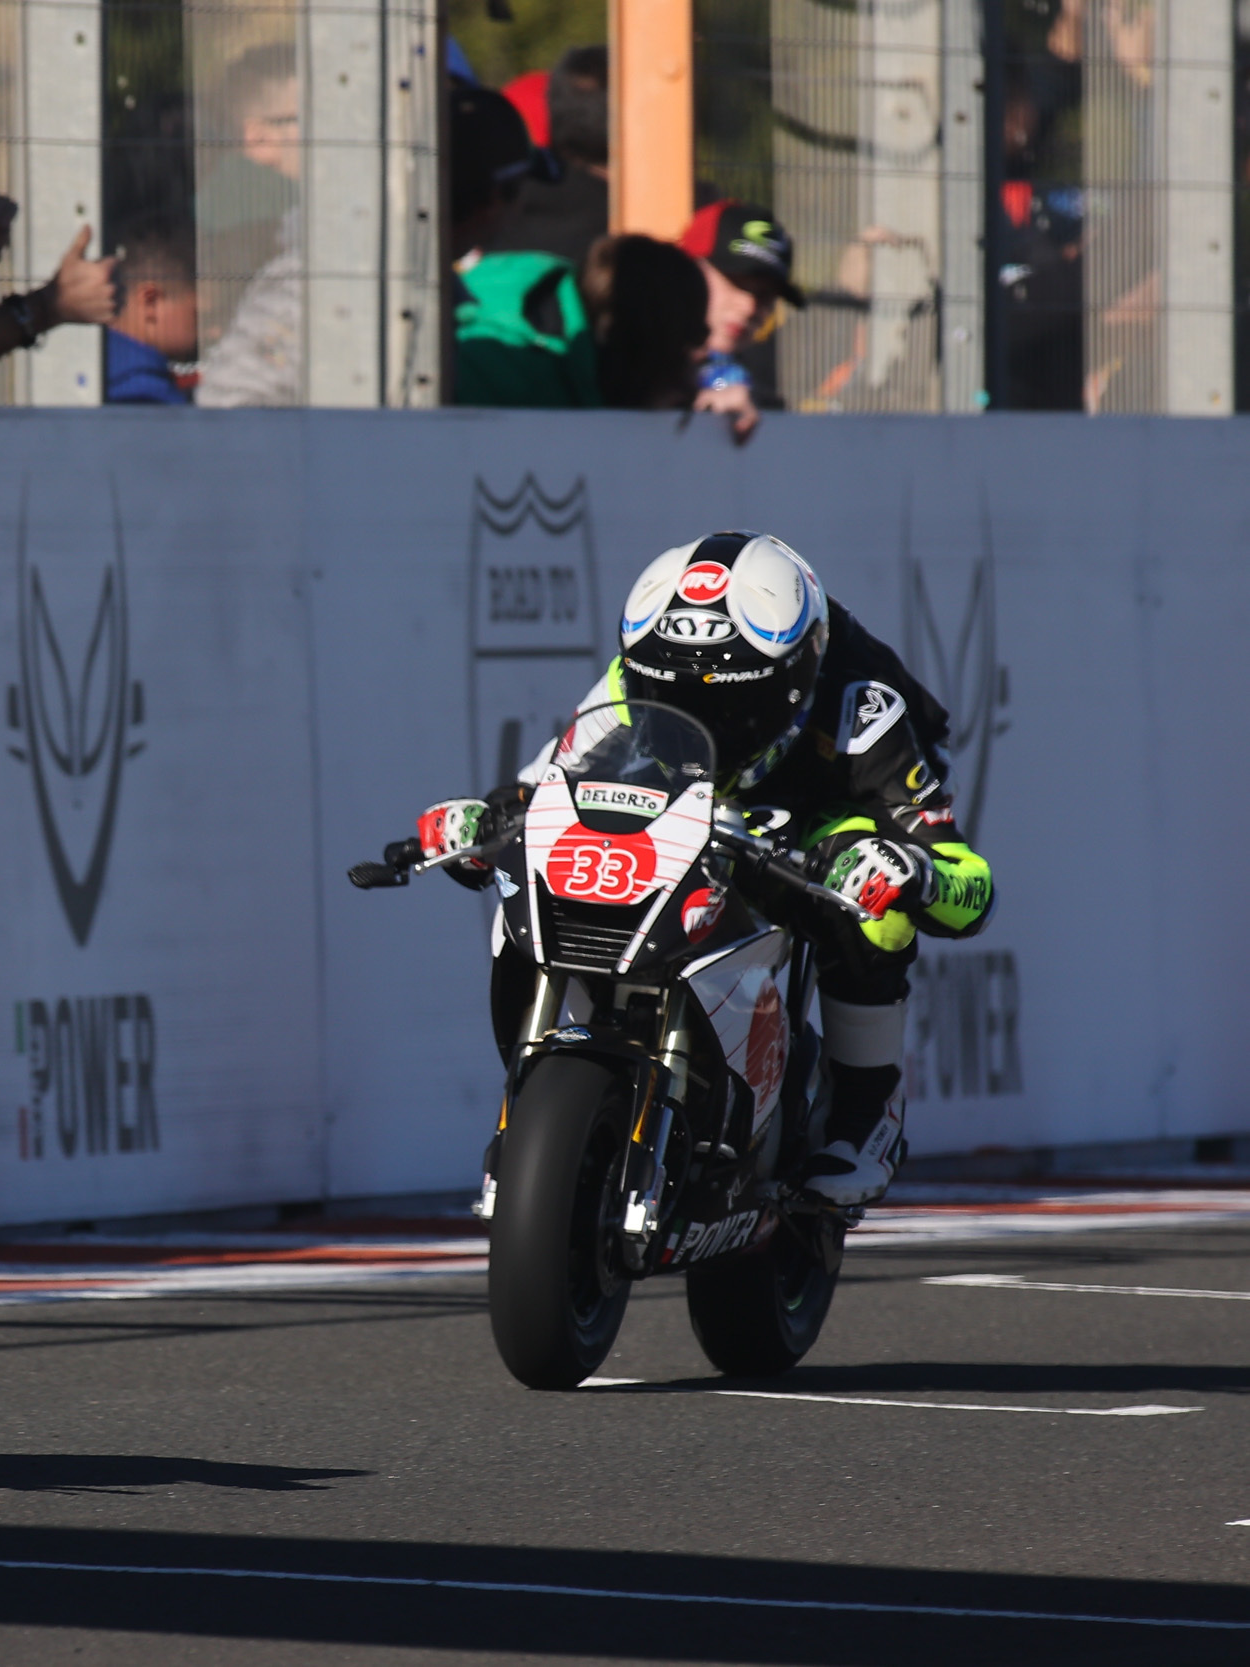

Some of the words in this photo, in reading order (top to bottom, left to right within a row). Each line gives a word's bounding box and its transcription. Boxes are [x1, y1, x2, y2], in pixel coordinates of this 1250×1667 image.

[658, 615, 729, 637] KYT
[703, 666, 775, 685] OHVALE
[581, 787, 658, 811] DELLORTO
[564, 844, 638, 898] 33
[670, 1208, 760, 1266] POWER
